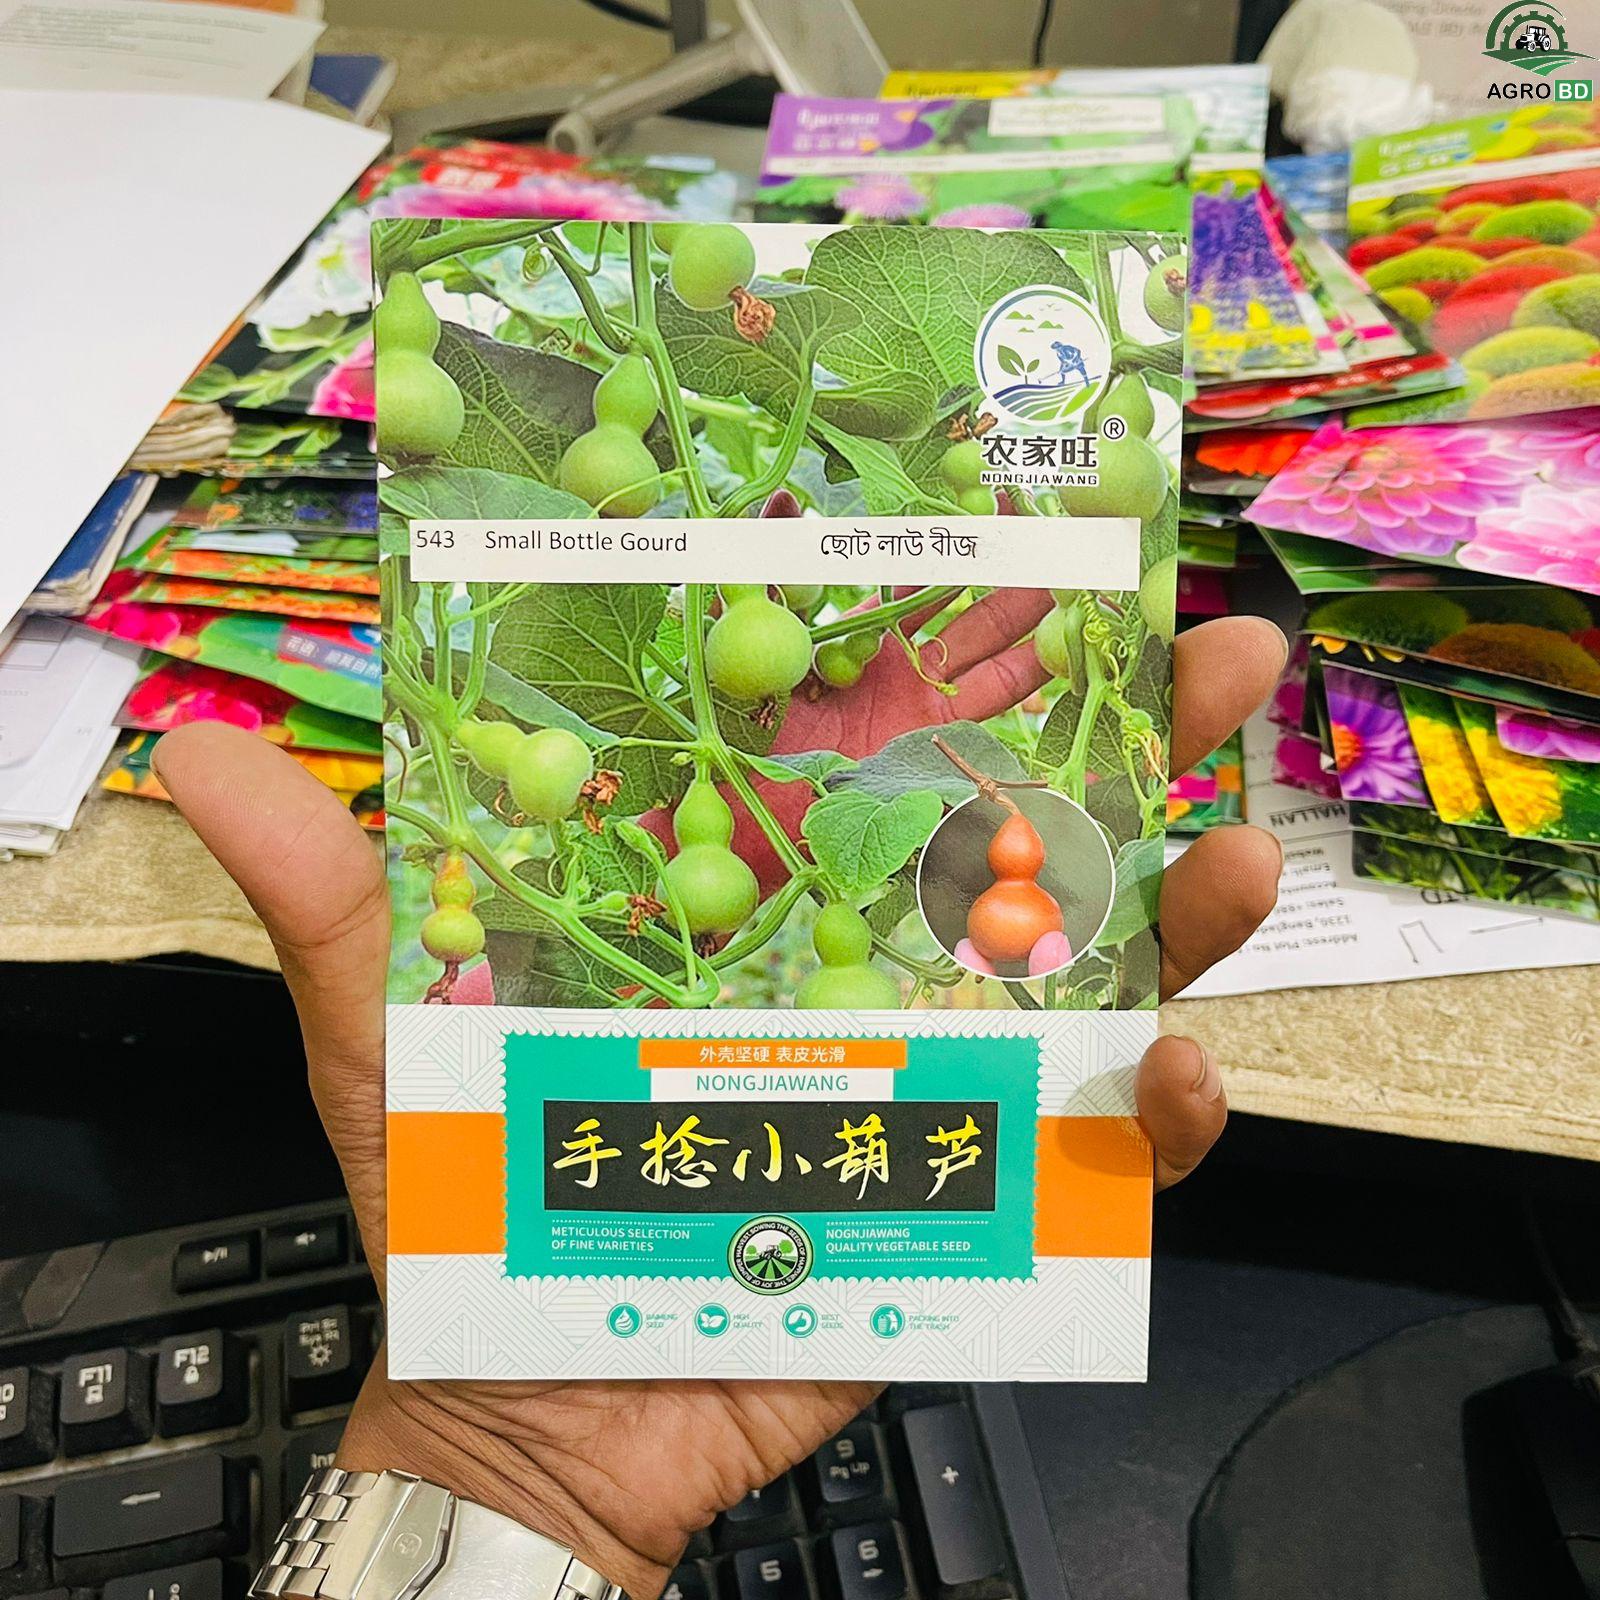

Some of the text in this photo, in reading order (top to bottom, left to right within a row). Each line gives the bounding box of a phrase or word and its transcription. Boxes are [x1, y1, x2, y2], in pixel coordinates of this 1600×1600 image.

[982, 434, 1097, 467] 农家旺
[981, 473, 1097, 485] NONGJIAWANG
[416, 530, 687, 551] 543 Small Bottle Gourd
[821, 526, 978, 559] ছোট লাউ বীজ
[700, 1046, 846, 1063] 外壳坚硬 表皮光滑
[697, 1075, 849, 1091] NONGJIAWANG
[553, 1113, 982, 1201] 手捻小葫芦
[551, 1227, 690, 1240] METICULOUS SELECTION
[826, 1228, 910, 1239] NOGNJIAWANG
[551, 1240, 654, 1252] OF FINE VARIETIES
[826, 1241, 971, 1254] QUALITY VEGETABLE SEED
[174, 1345, 210, 1369] F12
[78, 1363, 113, 1387] F11
[836, 1439, 855, 1458] 9
[858, 1539, 880, 1561] 6
[759, 1559, 783, 1583] 5
